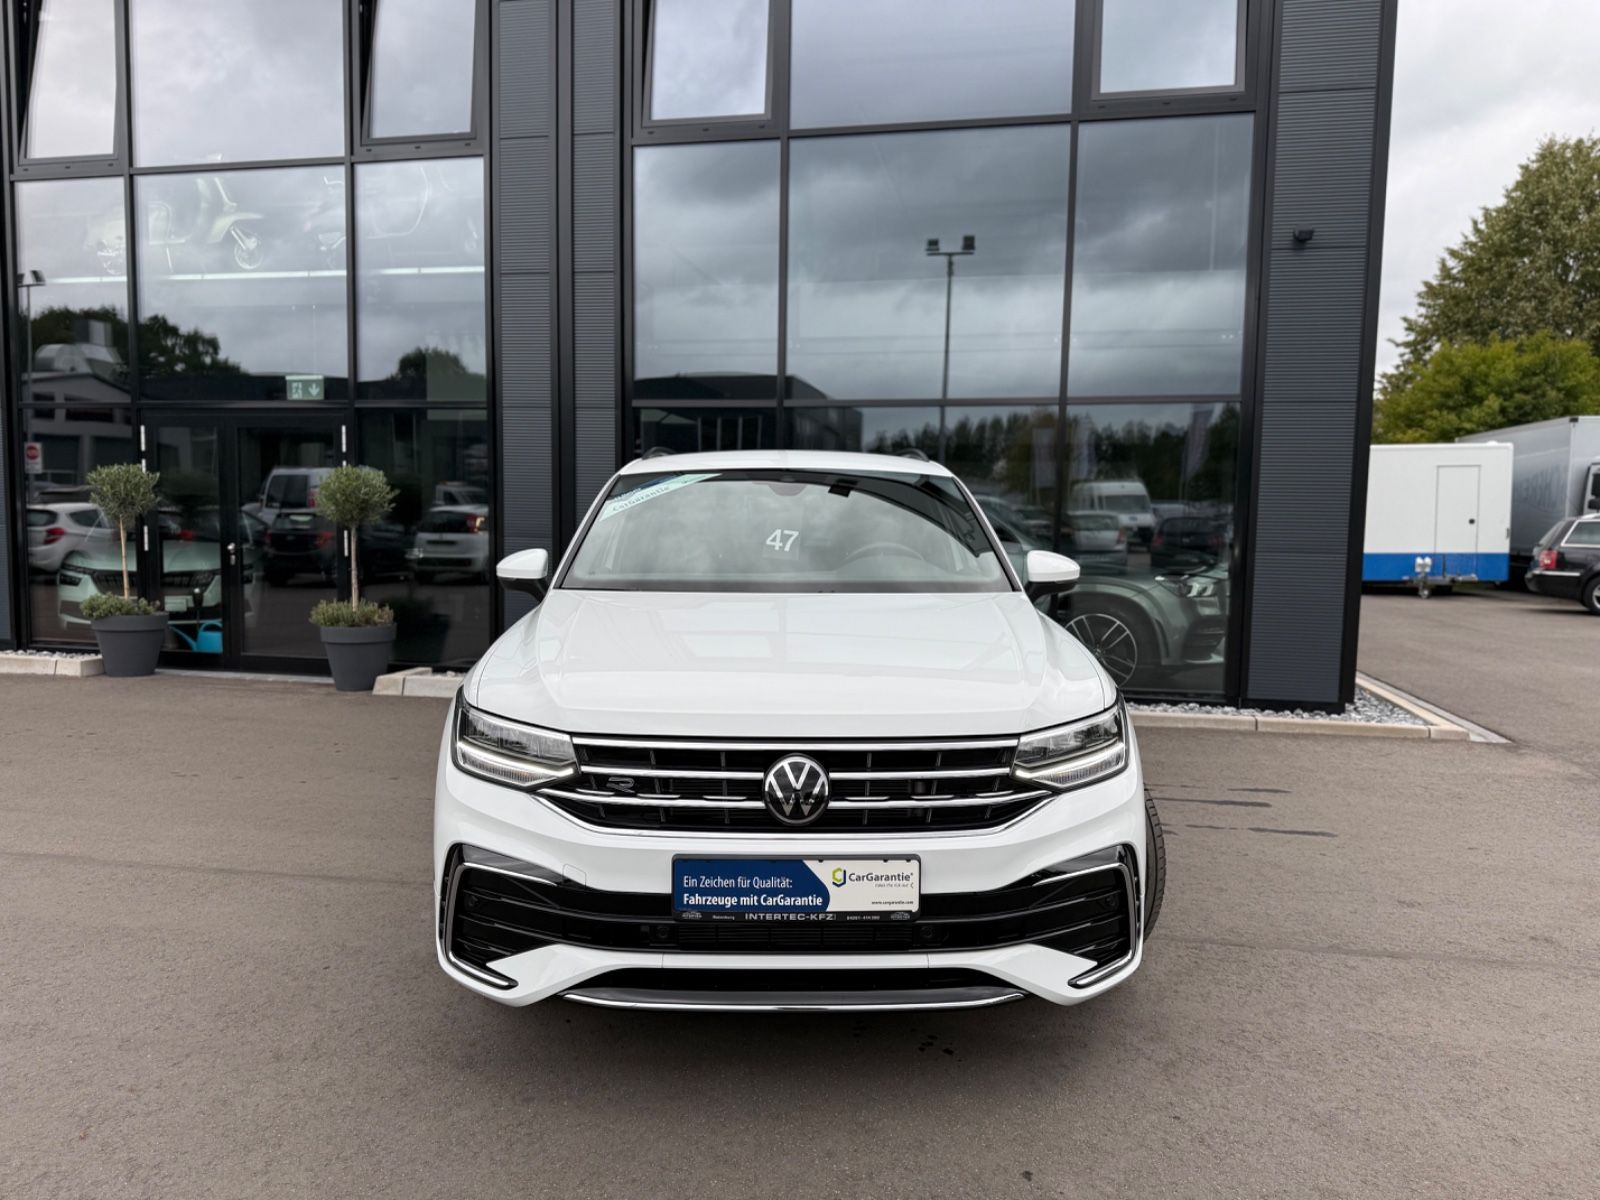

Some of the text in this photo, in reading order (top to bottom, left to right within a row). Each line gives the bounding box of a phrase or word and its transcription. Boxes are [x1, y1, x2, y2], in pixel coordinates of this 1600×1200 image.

[765, 528, 800, 552] 47
[683, 875, 793, 889] Ein Zeichen für Qualität:
[683, 893, 823, 908] Fahrzeuge mit CarGarantie
[745, 913, 834, 921] INTERTEC-KFZ
